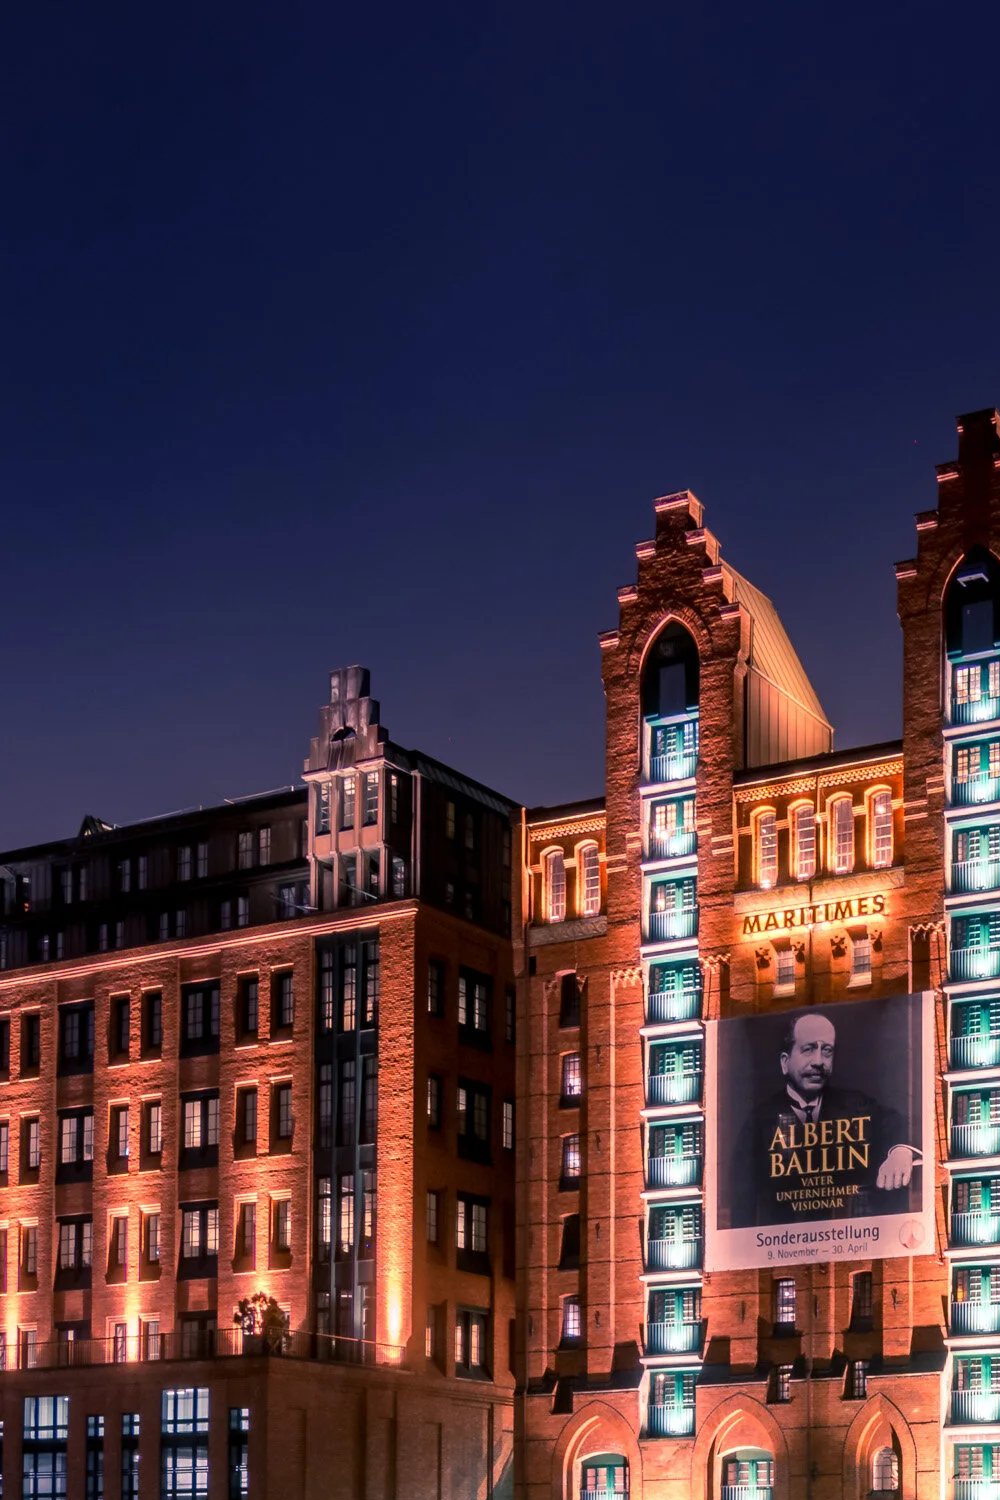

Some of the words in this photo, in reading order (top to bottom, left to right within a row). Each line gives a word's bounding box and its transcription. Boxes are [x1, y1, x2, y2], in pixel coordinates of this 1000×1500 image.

[743, 894, 885, 934] MARITIMES
[768, 1116, 871, 1151] ALBERT
[769, 1143, 870, 1177] BALLIN
[801, 1175, 834, 1187] VATER
[776, 1184, 860, 1202] UNTERNEHMER
[756, 1225, 880, 1248] Sonderausstellung
[767, 1250, 775, 1260] 9.
[777, 1247, 819, 1259] November
[832, 1244, 844, 1255] 30.
[847, 1241, 868, 1254] April
